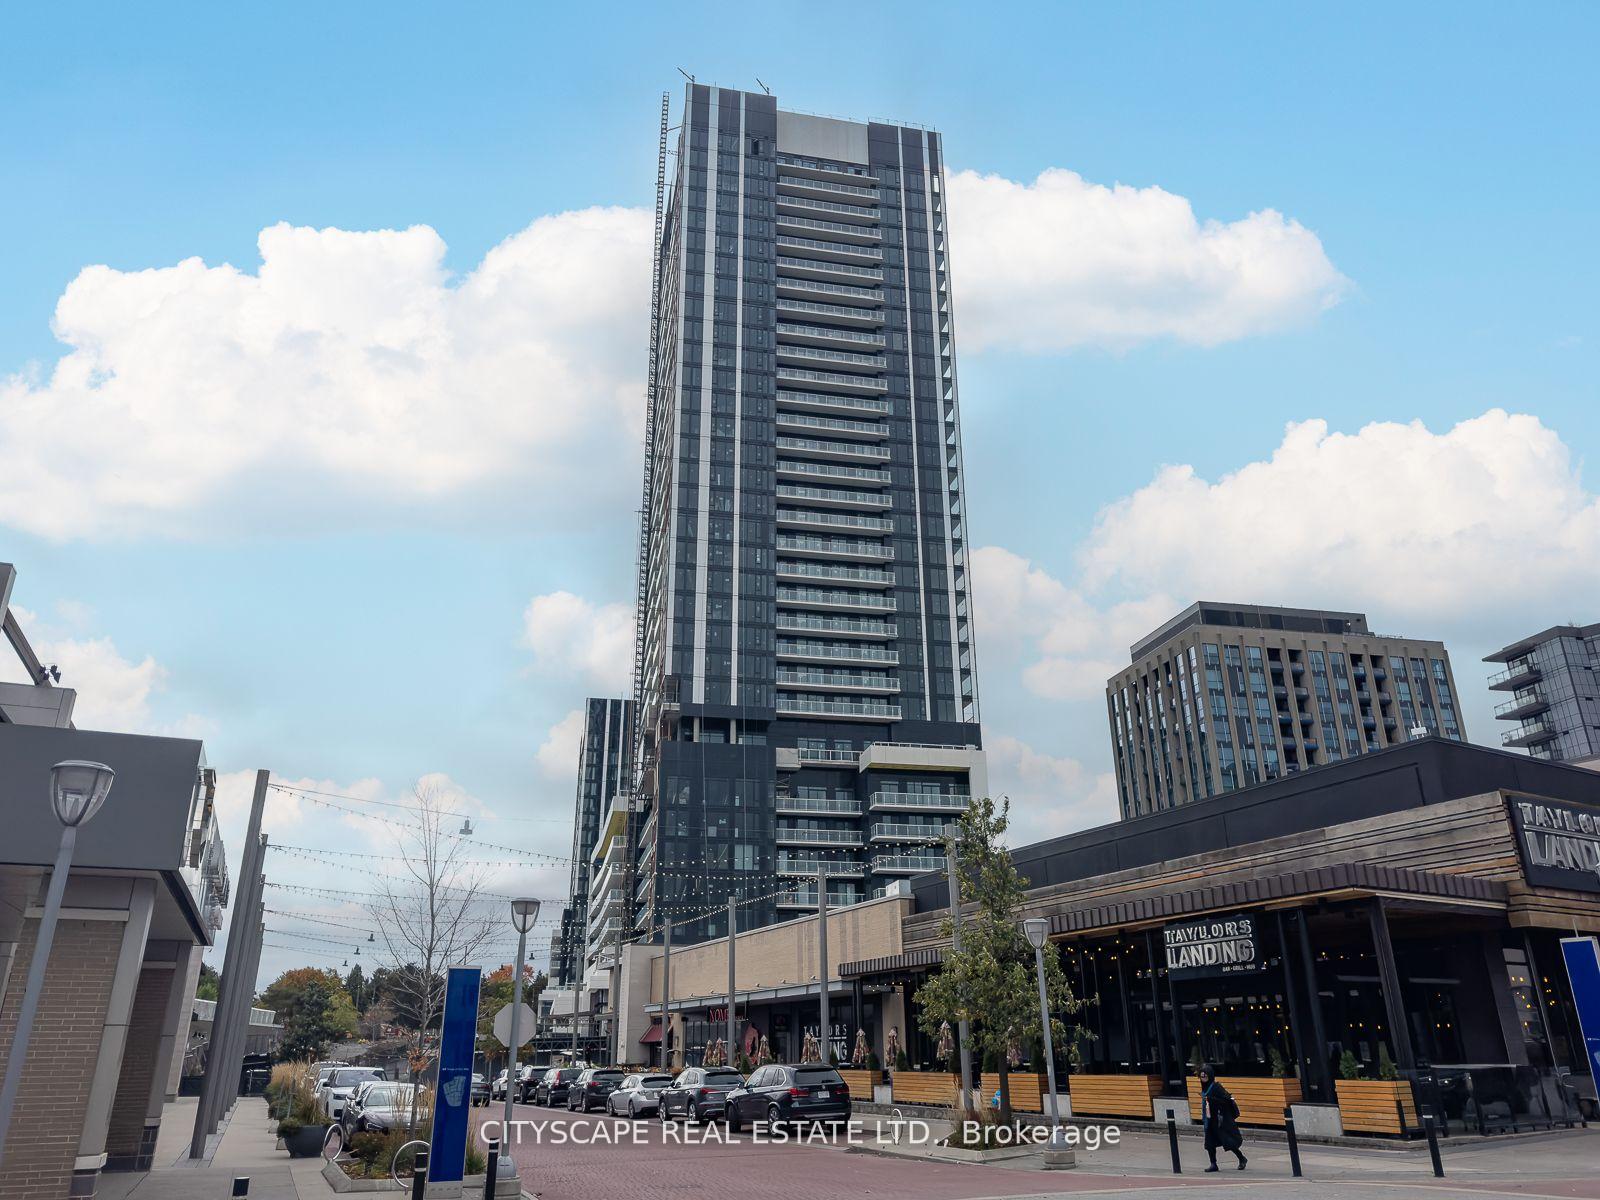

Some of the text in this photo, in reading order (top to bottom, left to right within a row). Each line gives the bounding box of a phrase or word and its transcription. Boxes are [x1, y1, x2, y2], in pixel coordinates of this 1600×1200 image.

[1164, 919, 1252, 943] TAYLORS
[1166, 939, 1255, 969] LANDING
[803, 1023, 848, 1037] TAYORS
